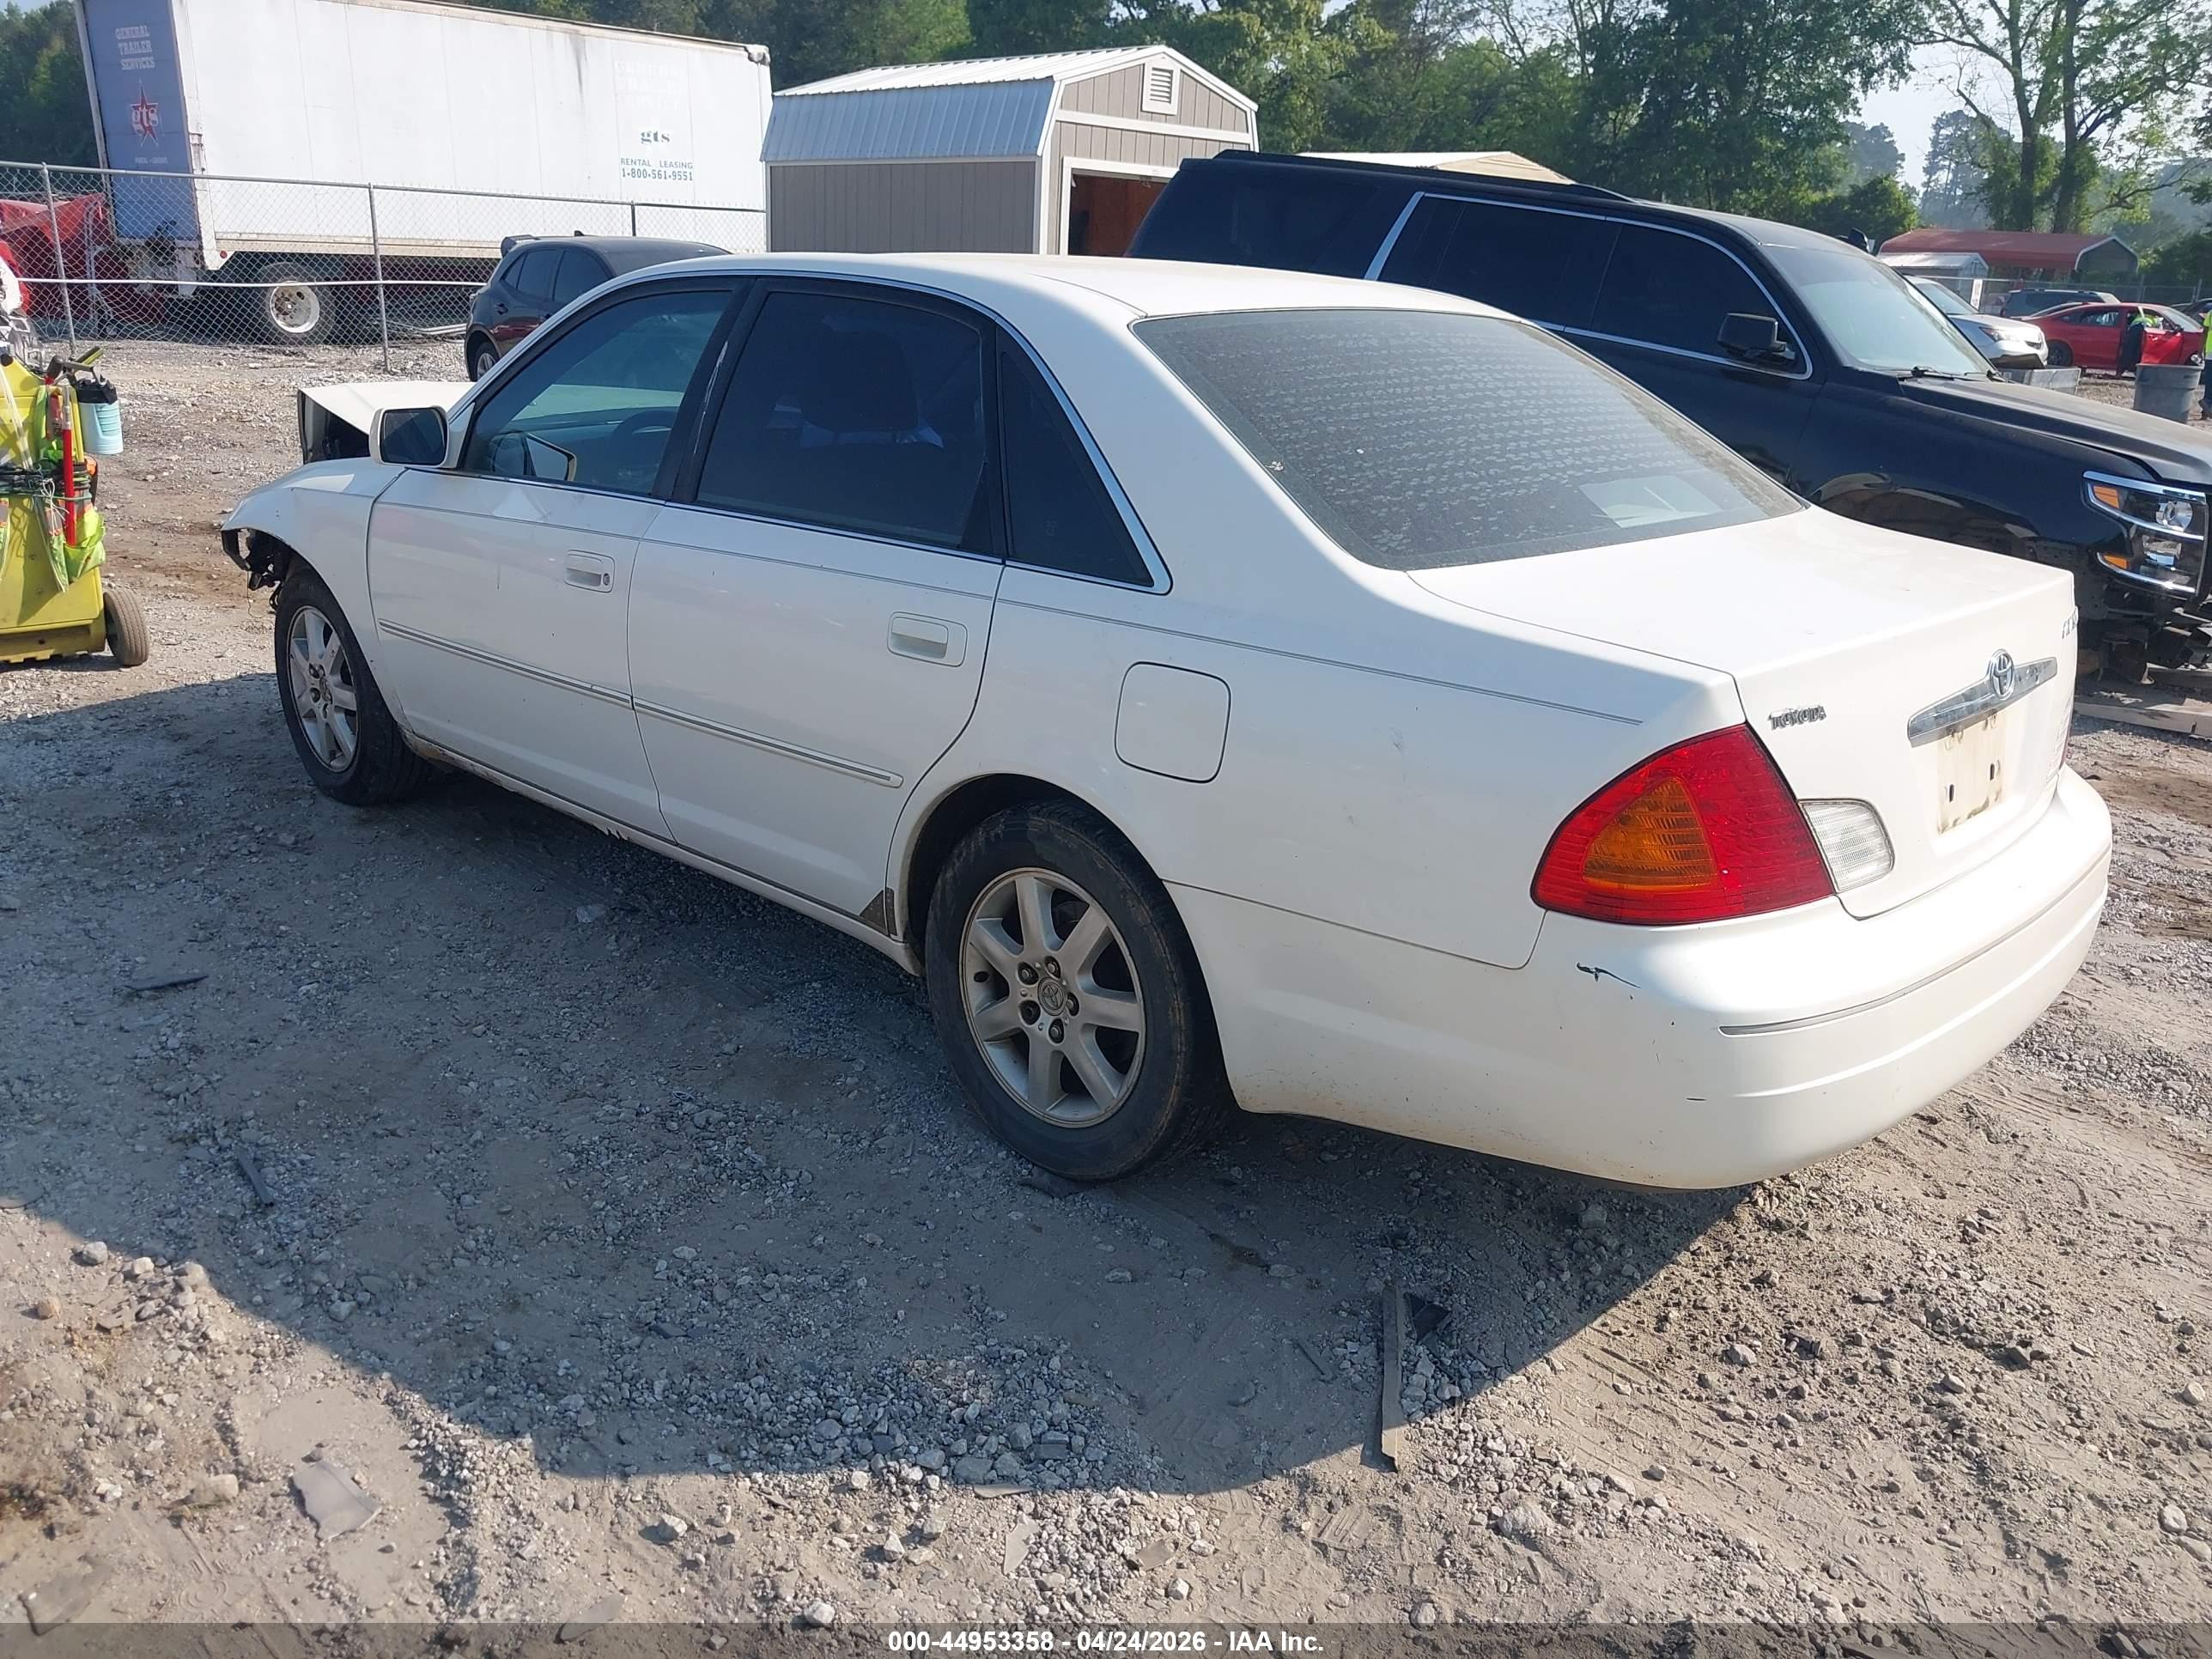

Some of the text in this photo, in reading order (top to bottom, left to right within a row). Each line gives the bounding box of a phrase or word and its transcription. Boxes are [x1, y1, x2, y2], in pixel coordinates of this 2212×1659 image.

[115, 25, 150, 40] GENERAL
[118, 40, 153, 56] TRAILER
[120, 57, 155, 70] SERVICES
[641, 131, 671, 144] gts
[620, 157, 693, 169] RENTAL LEASING
[1768, 705, 1827, 730] TOYOTA
